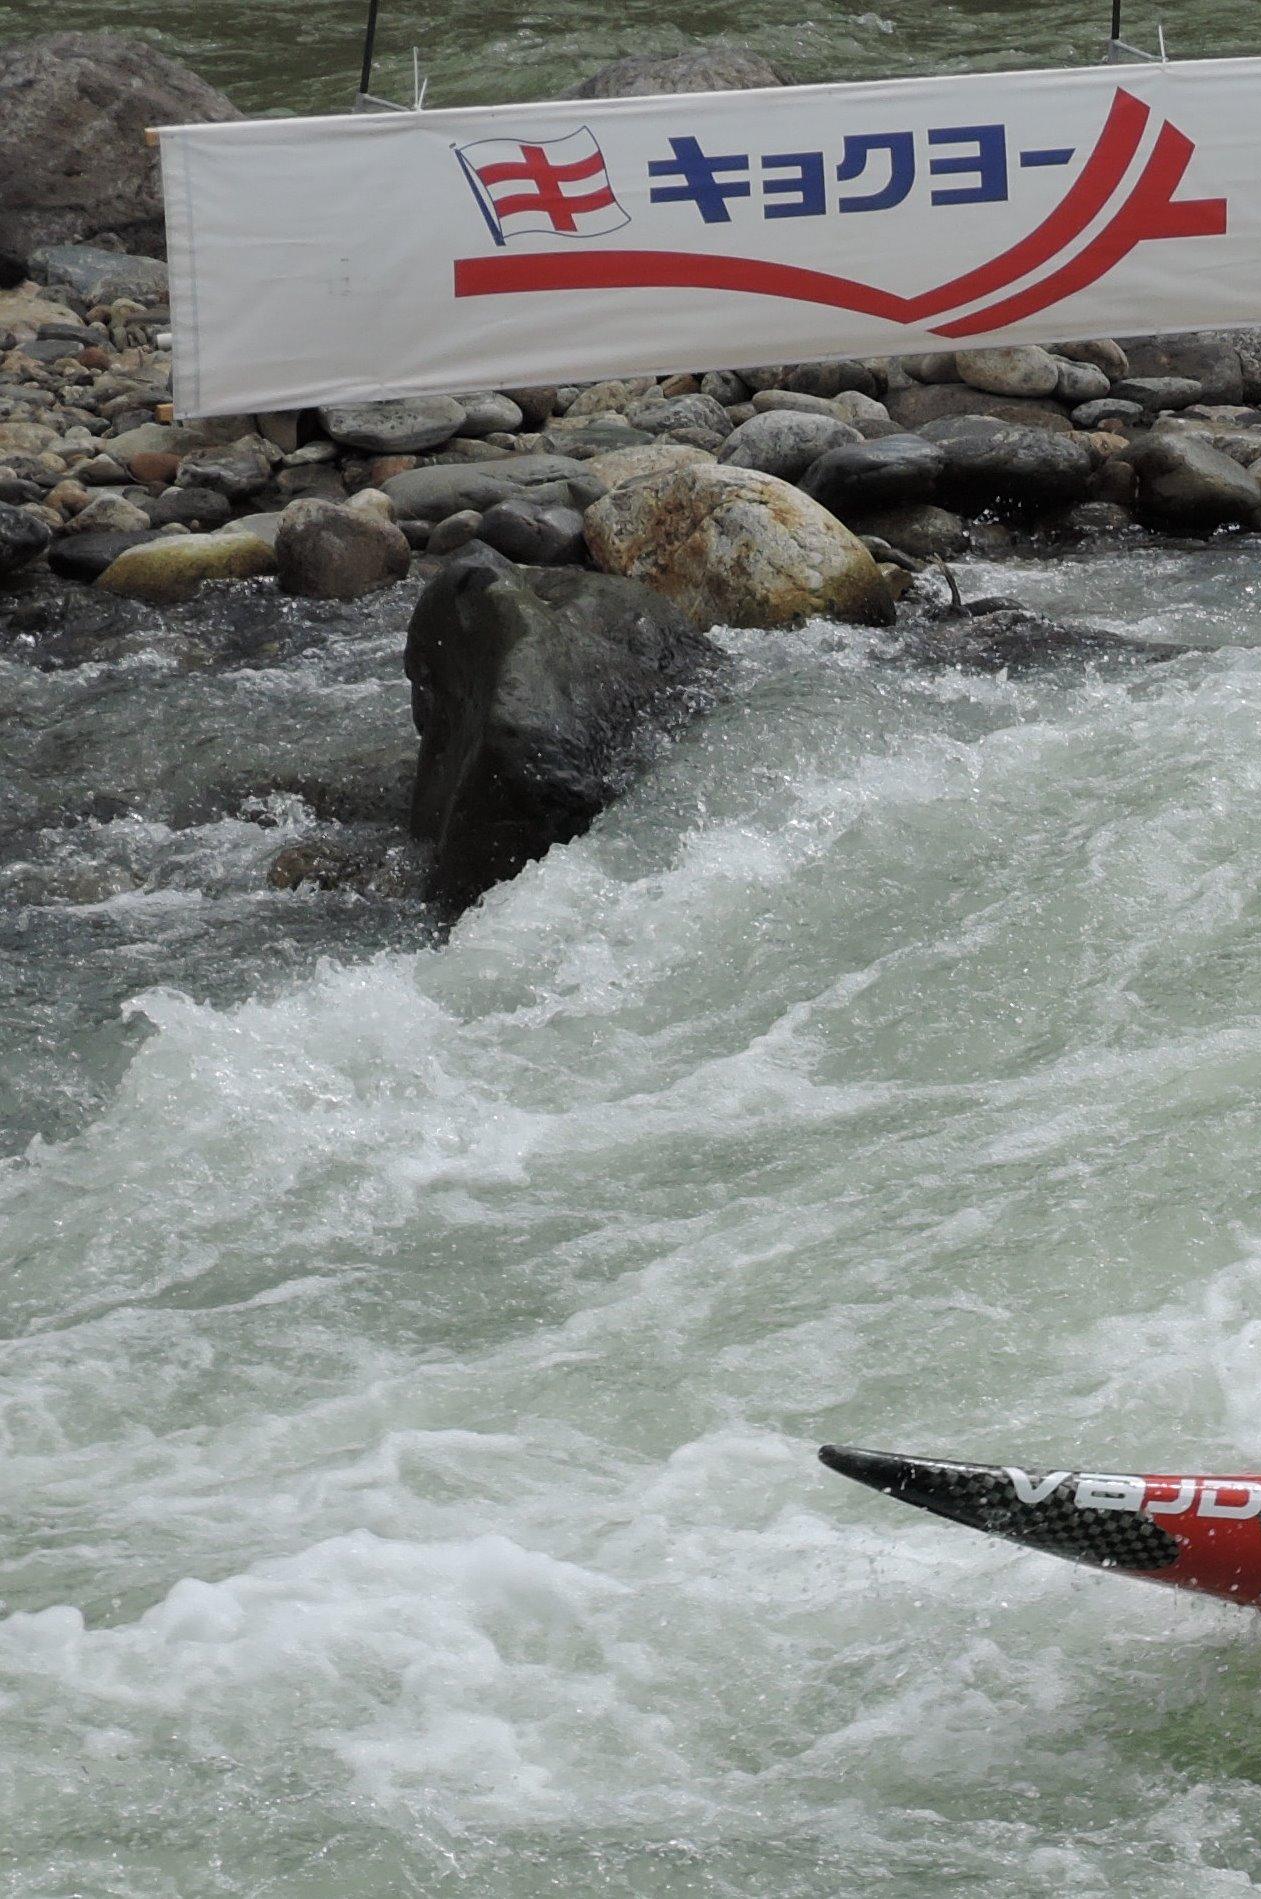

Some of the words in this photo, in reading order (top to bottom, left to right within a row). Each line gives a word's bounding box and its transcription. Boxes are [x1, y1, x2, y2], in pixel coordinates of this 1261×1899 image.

[647, 123, 1076, 225] キョクヨー
